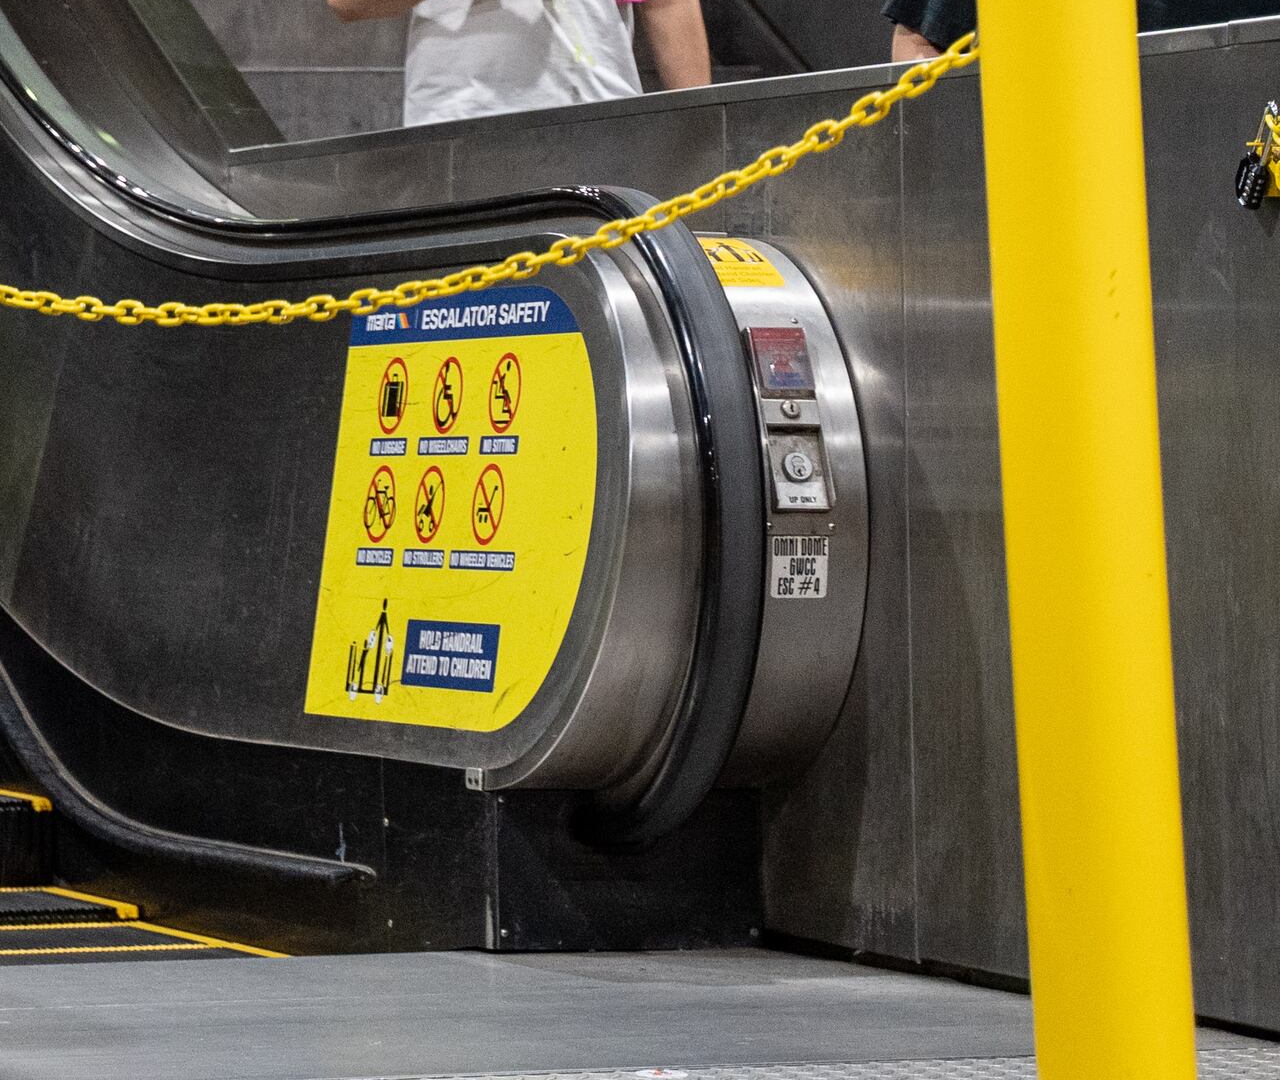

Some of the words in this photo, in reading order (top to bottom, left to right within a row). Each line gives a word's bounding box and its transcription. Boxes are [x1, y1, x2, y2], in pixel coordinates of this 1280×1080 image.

[366, 312, 397, 332] marta
[421, 305, 497, 330] ESCALATOR
[499, 301, 551, 325] SAFETY
[372, 440, 380, 454] NO
[381, 439, 406, 454] LUGGAGE
[419, 439, 428, 454] NO
[428, 439, 468, 454] WHEELCHAIRS
[482, 439, 492, 453] NO
[492, 438, 515, 453] SITTING
[789, 496, 798, 504] UP
[774, 537, 798, 556] OMNI
[801, 537, 827, 556] DOME
[357, 549, 366, 563] NO
[366, 549, 392, 564] BICYCLES
[404, 550, 412, 565] NO
[412, 551, 444, 565] STROLLERS
[450, 552, 459, 566] NO
[459, 552, 486, 567] WHEELED
[486, 553, 514, 568] VEHICLES
[789, 557, 816, 576] GWCC
[777, 577, 795, 595] ESC
[798, 576, 820, 595] #4
[419, 629, 442, 651] HOLD
[441, 631, 484, 654] HANDRAIL
[406, 653, 438, 676] ATTEND
[438, 656, 450, 676] TO
[450, 657, 492, 680] CHILDREN
